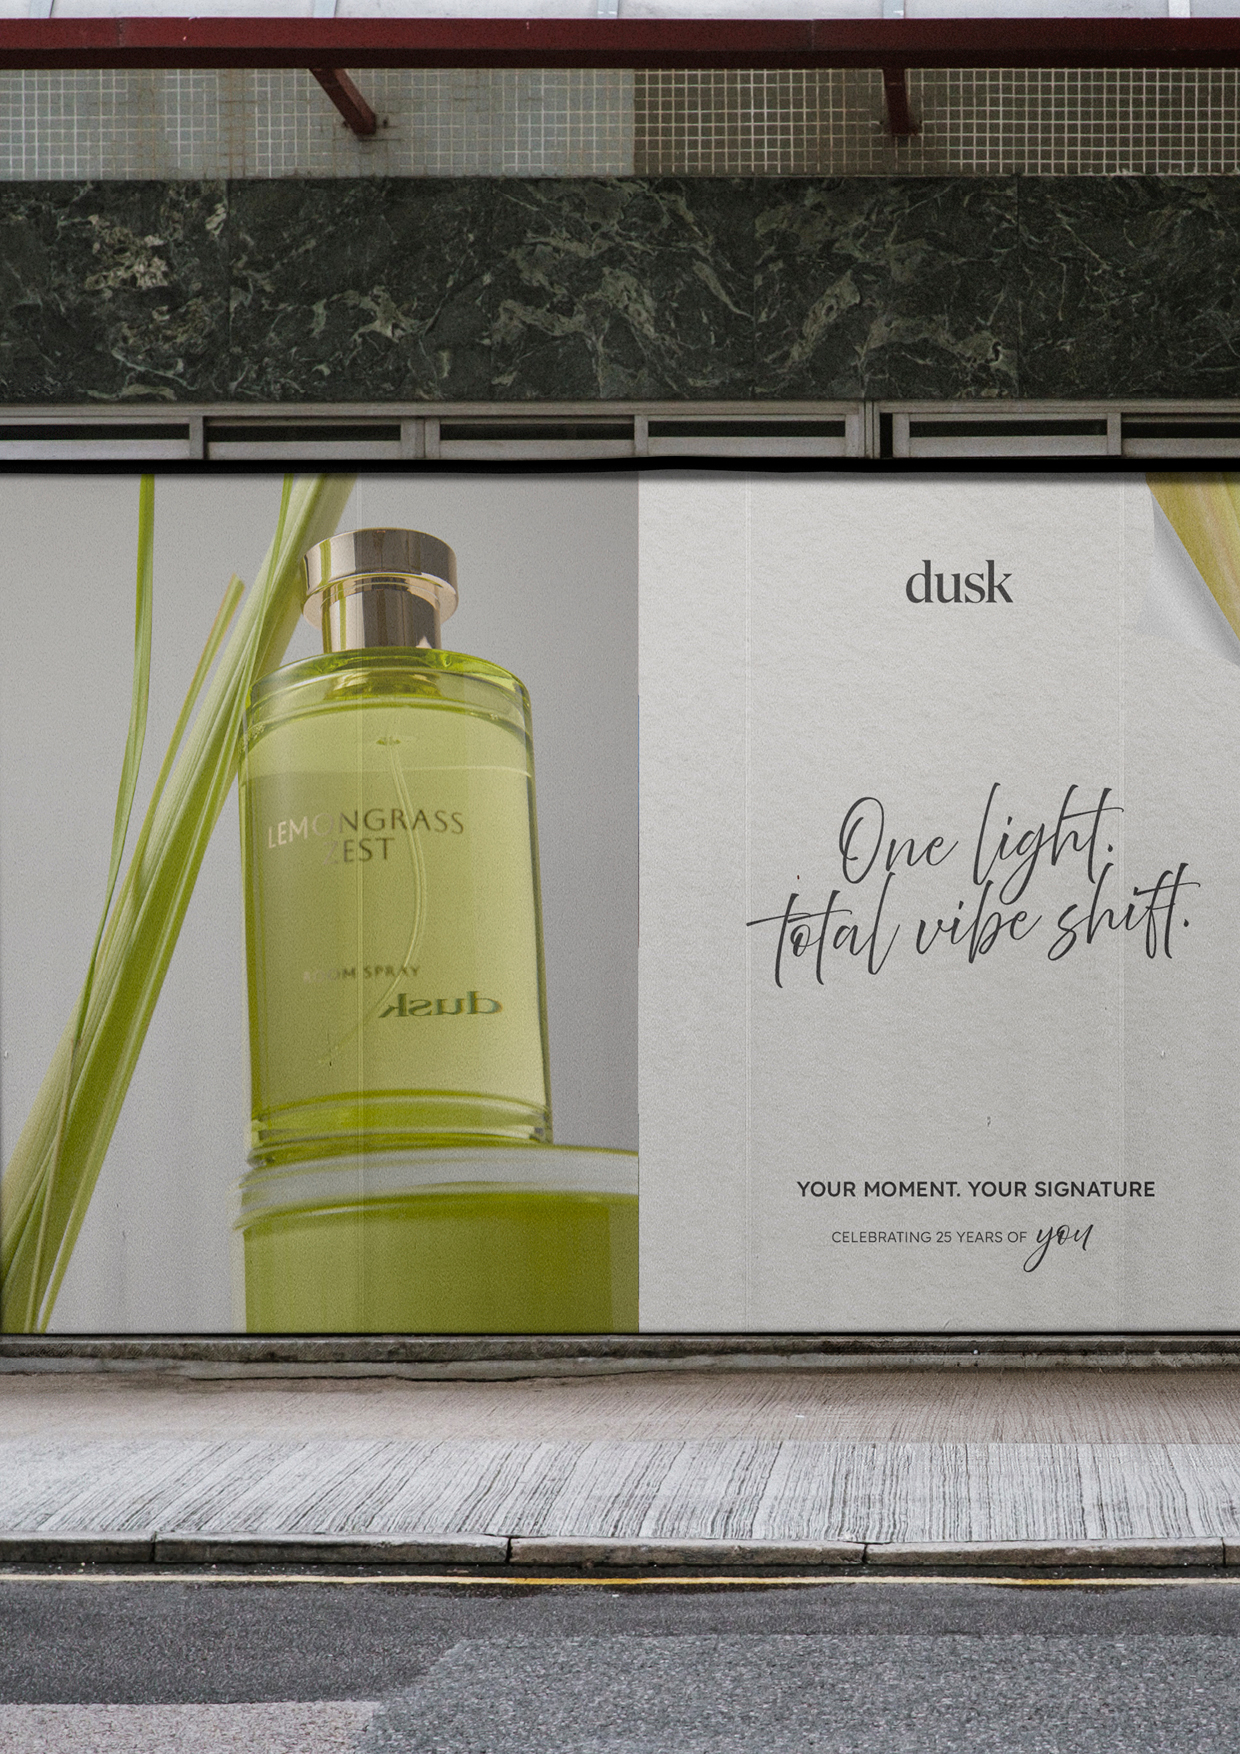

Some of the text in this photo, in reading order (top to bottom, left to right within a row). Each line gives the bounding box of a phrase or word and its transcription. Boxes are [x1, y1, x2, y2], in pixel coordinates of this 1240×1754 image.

[905, 559, 1014, 604] dusk
[267, 807, 465, 849] LEMONGRASS
[838, 781, 1125, 906] One light.
[322, 837, 396, 866] ZEST
[745, 862, 1201, 988] total vibe shift.
[363, 965, 421, 979] SPRAY
[796, 1180, 1156, 1198] YOUR MOMENT. YOUR SIGNATURE
[831, 1223, 1095, 1273] CELEBRATING 25 YEARS OF you
